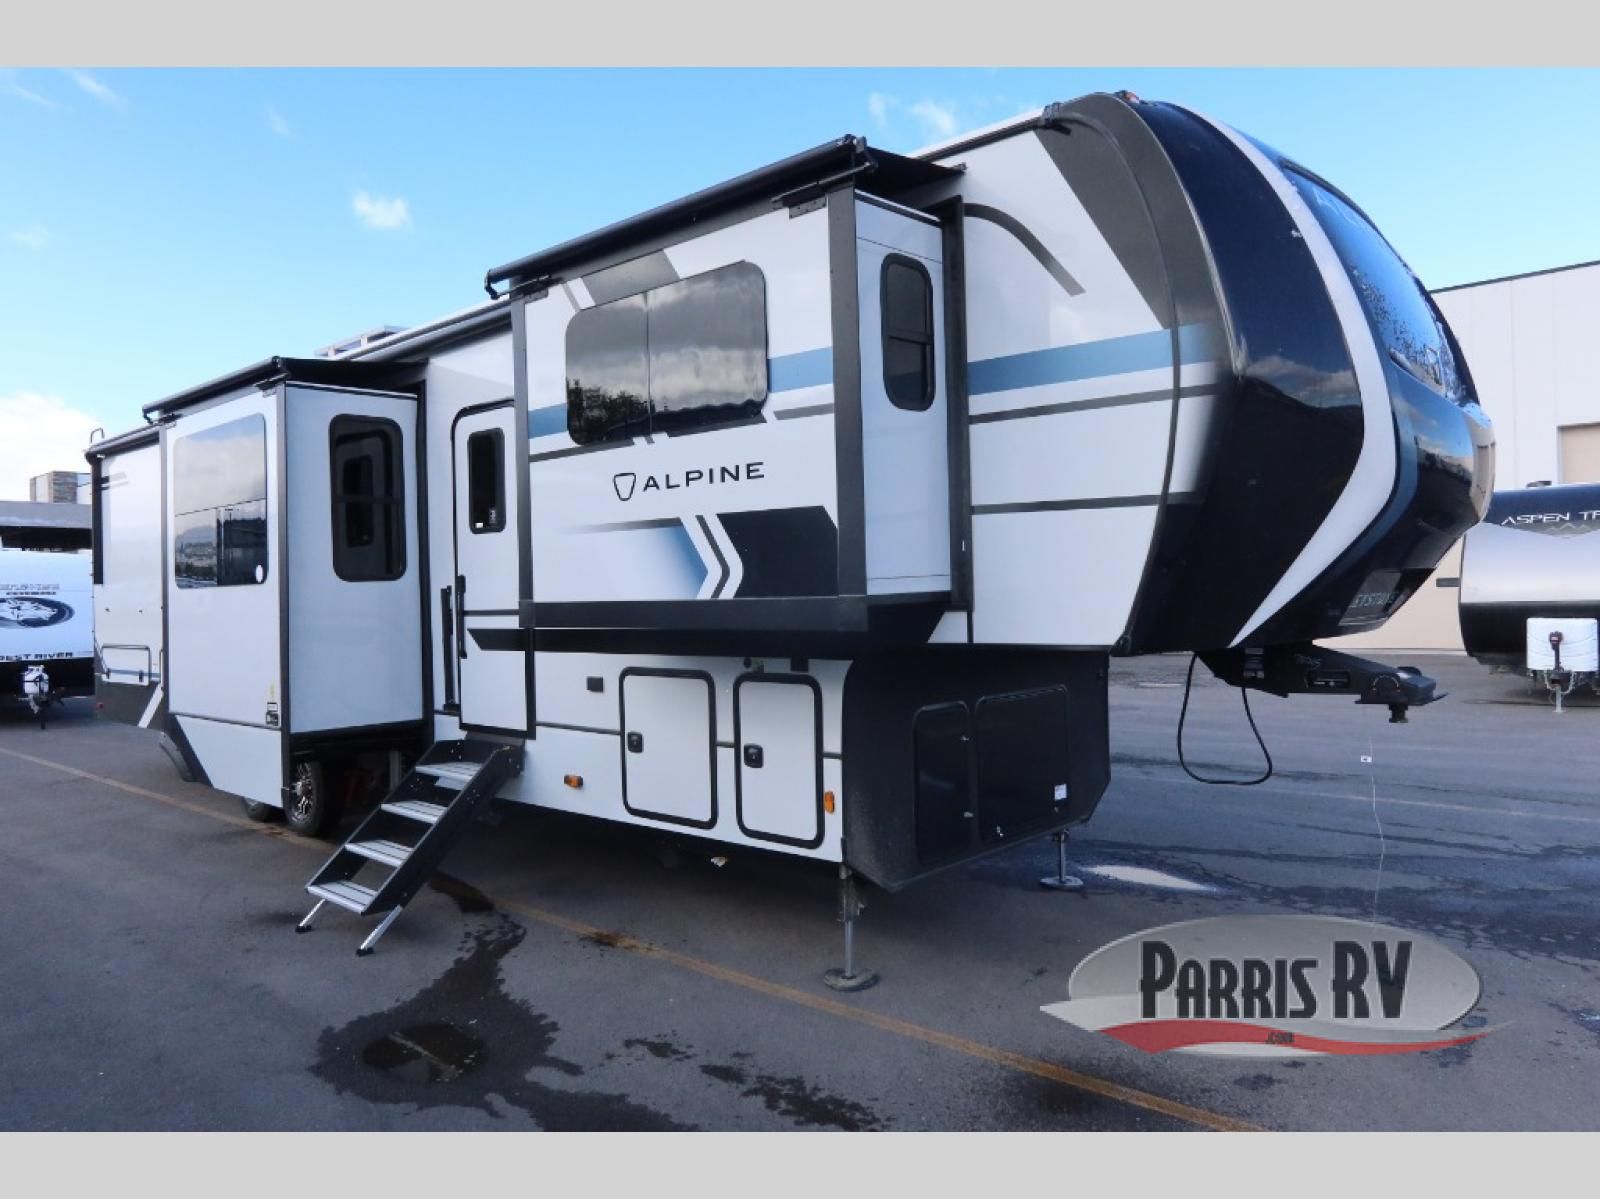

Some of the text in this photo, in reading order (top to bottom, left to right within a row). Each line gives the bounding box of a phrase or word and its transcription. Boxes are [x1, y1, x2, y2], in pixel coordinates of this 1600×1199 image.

[642, 461, 765, 492] ALPINE
[1501, 511, 1570, 526] ASPEN
[34, 651, 73, 660] RIVER
